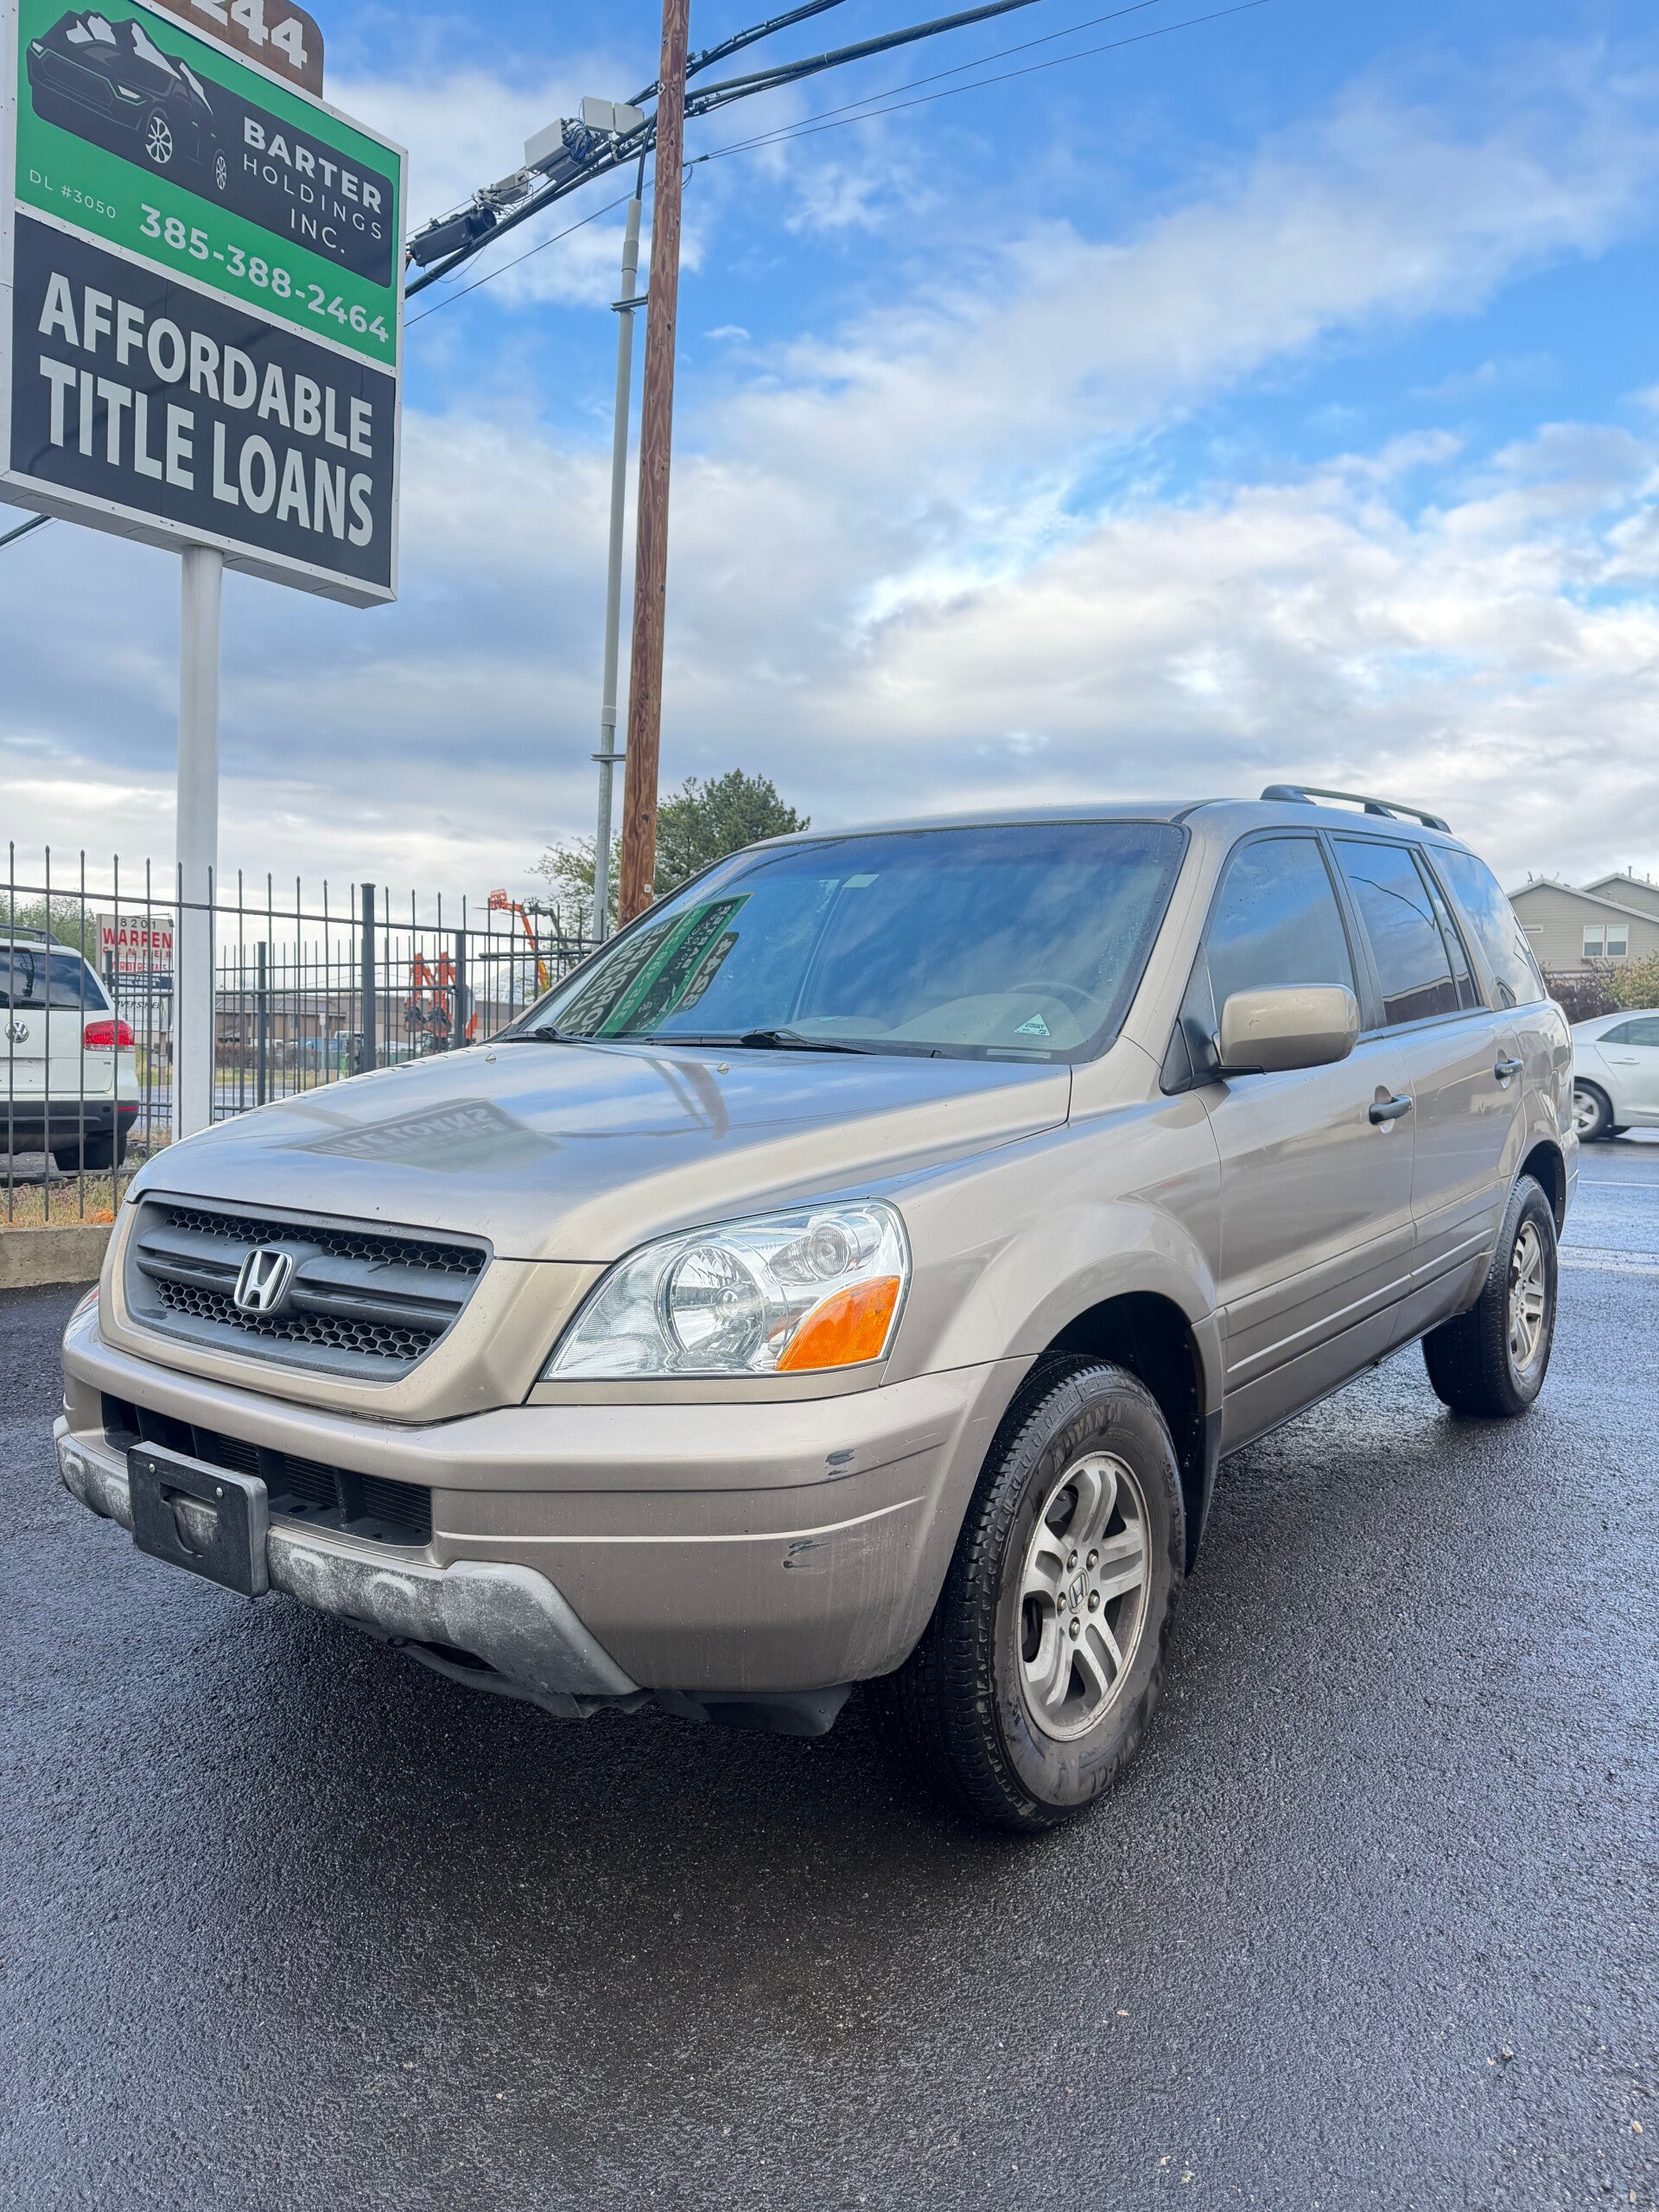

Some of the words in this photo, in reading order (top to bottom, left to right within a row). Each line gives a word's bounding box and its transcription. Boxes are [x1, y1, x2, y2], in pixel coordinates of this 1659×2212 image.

[29, 168, 54, 191] DL
[60, 184, 116, 219] #3050
[244, 116, 382, 214] BARTER
[244, 153, 382, 239] HOLDINGS
[139, 203, 389, 343] 385-388-2464
[290, 208, 346, 254] INC.
[37, 270, 373, 459] AFFORDABLE
[40, 354, 195, 492] TITLE
[212, 420, 373, 547] LOANS
[120, 918, 156, 930] 8201
